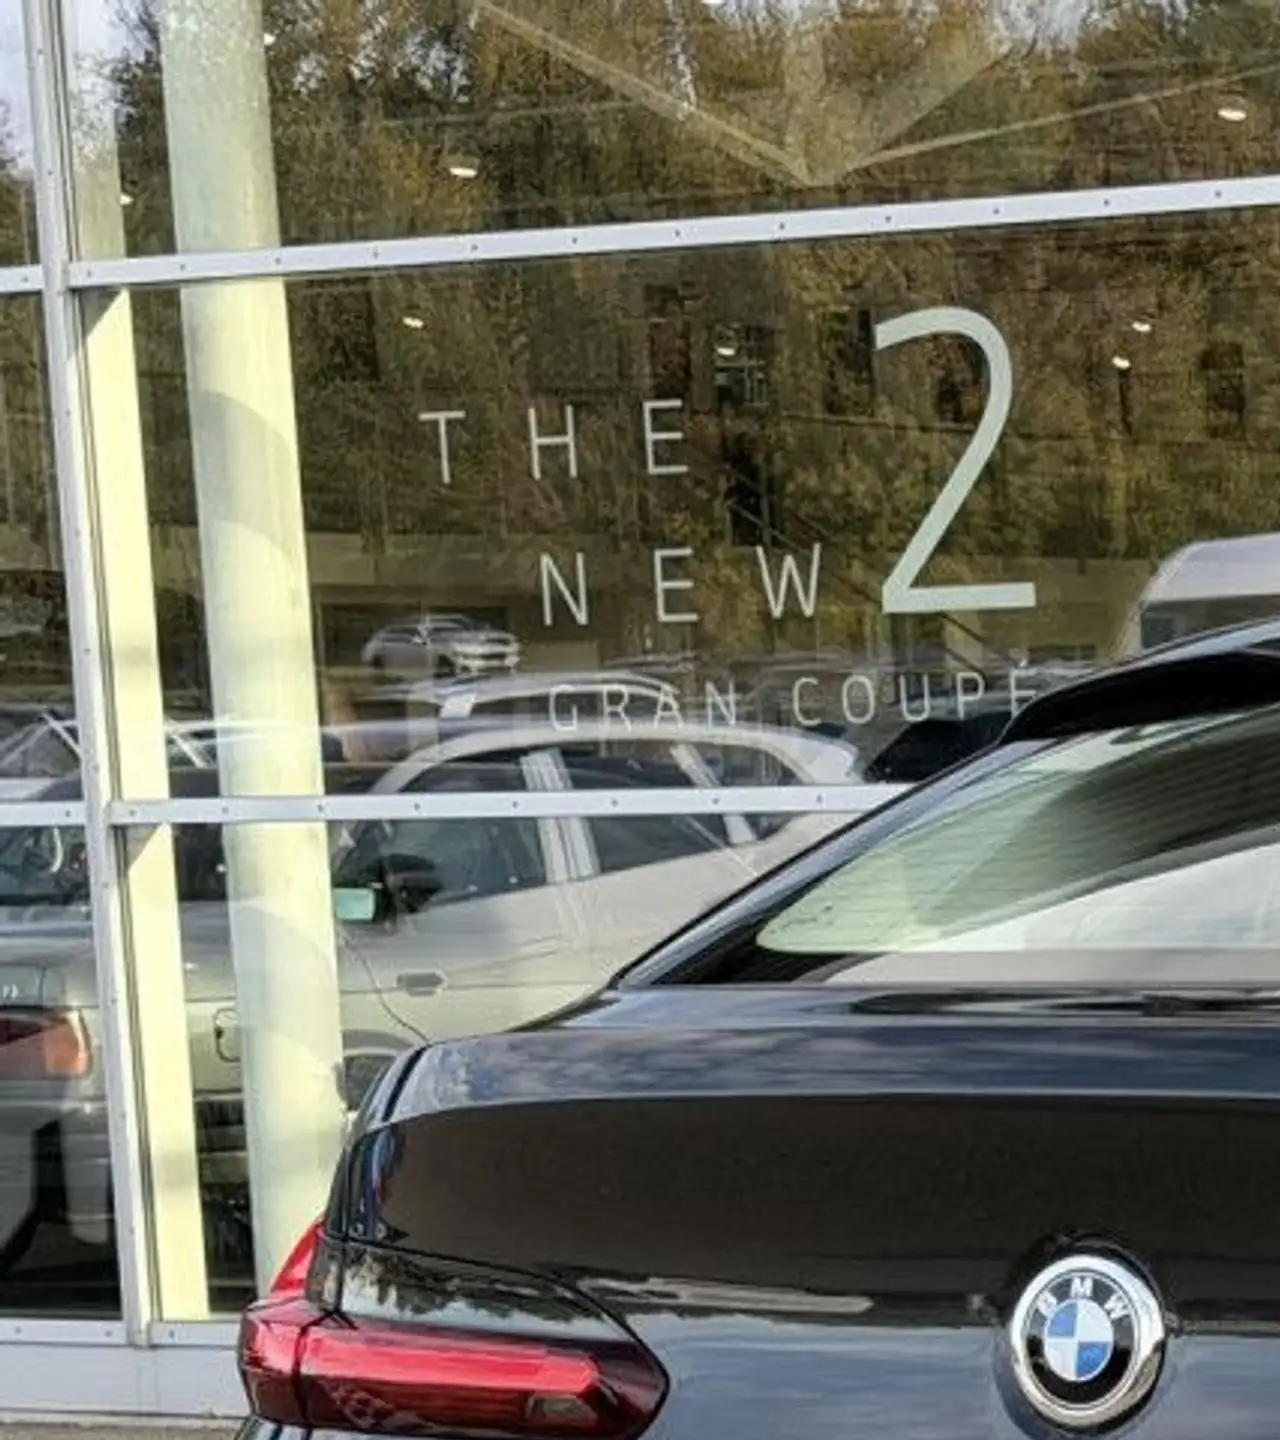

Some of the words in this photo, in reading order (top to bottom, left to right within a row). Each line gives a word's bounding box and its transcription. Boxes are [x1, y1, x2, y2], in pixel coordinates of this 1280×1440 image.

[417, 399, 690, 485] THE
[538, 541, 822, 627] NEW
[874, 305, 1037, 614] 2
[547, 681, 739, 732] GRAN
[1033, 1275, 1132, 1320] BMW
